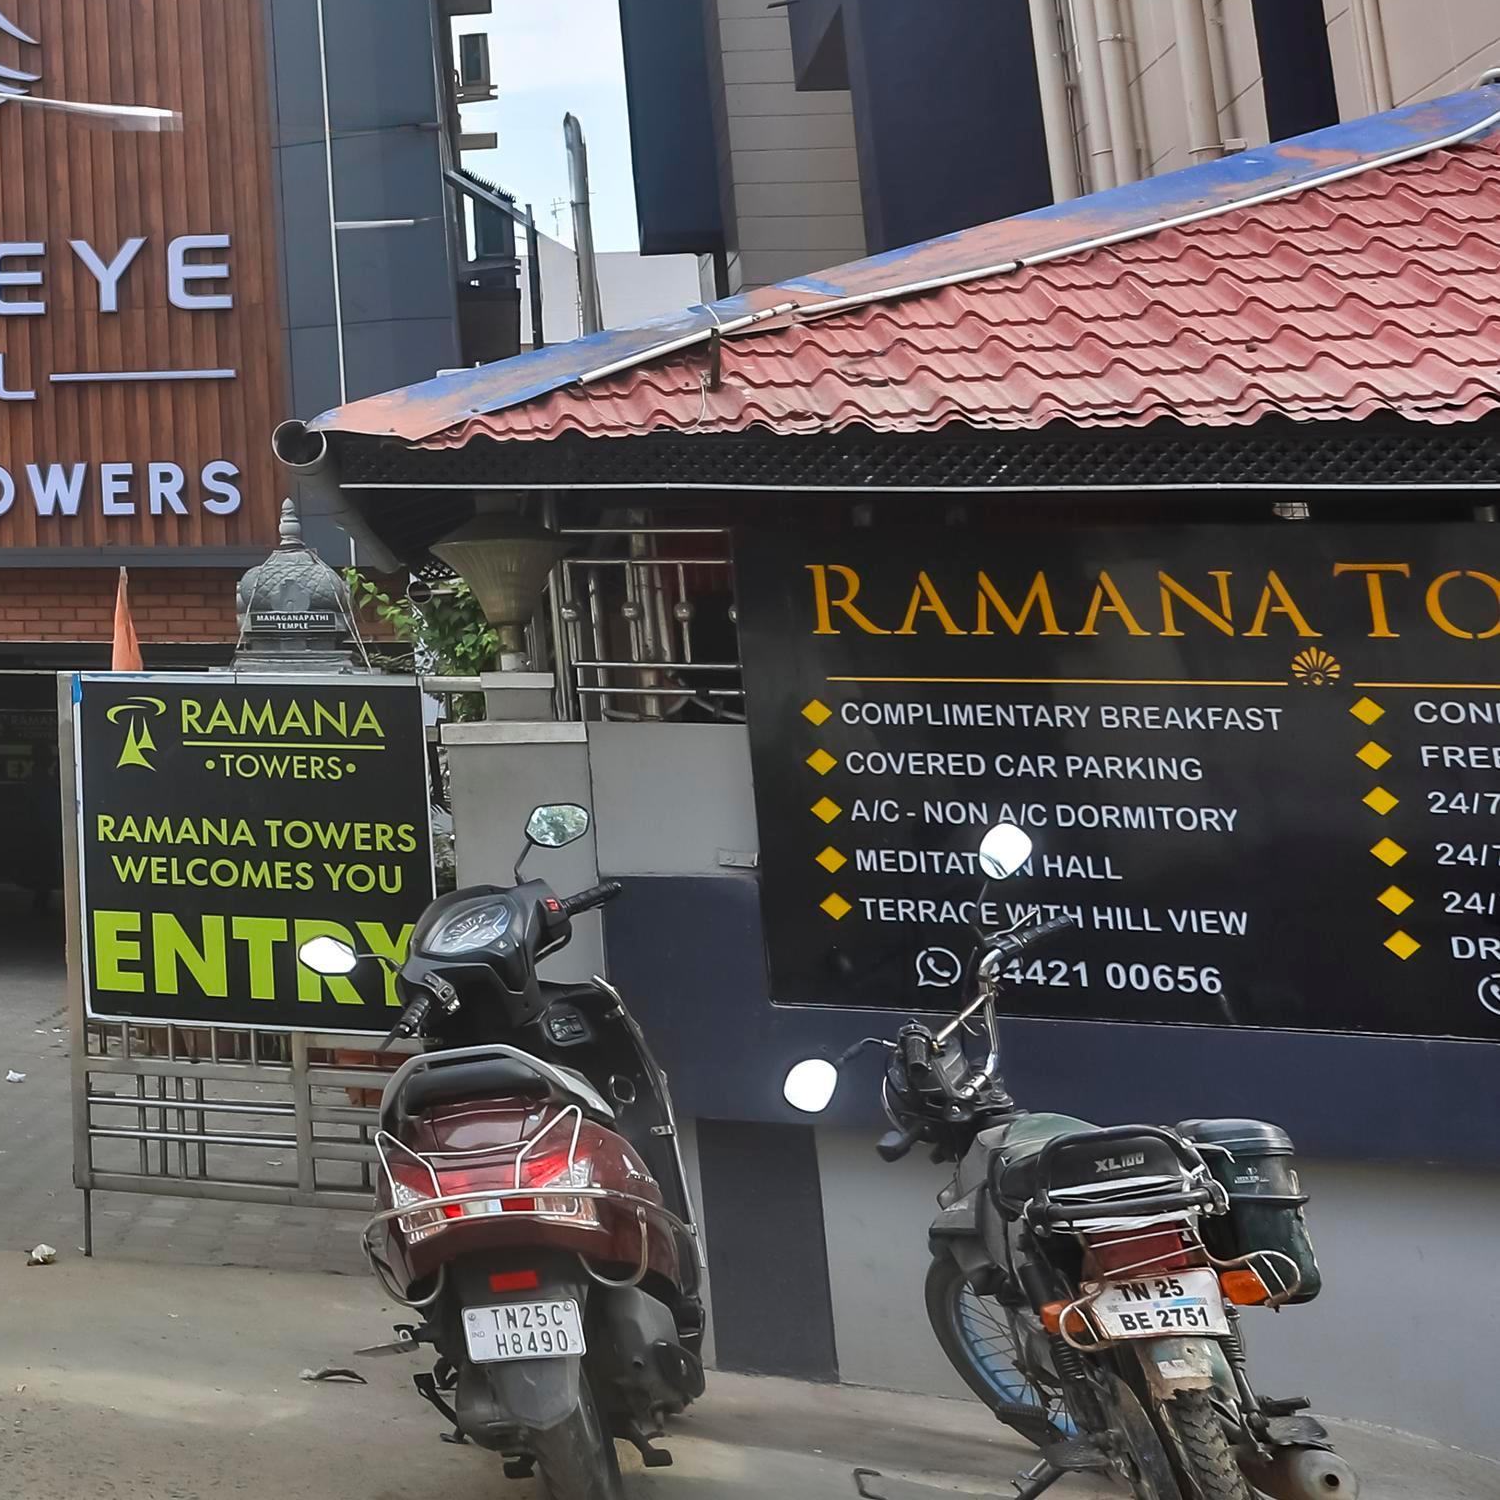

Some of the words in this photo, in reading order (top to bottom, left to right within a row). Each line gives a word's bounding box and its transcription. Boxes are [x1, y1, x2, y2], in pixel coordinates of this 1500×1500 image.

[804, 564, 1323, 637] RAMANA
[1333, 563, 1500, 639] TO
[181, 698, 385, 738] RAMANA
[841, 702, 1090, 728] COMPLIMENTARY
[1100, 707, 1283, 731] BREAKFAST
[1414, 701, 1500, 724] CON
[220, 754, 342, 780] TOWERS
[845, 752, 985, 776] COVERED
[995, 755, 1057, 778] CAR
[1066, 756, 1203, 782] PARKING
[851, 800, 899, 823] A/C
[924, 801, 988, 825] NON
[999, 802, 1048, 827] A/C
[1056, 804, 1238, 832] DORMITORY
[98, 814, 256, 847] RAMANA
[265, 820, 416, 852] TOWERS
[111, 855, 314, 891] WELCOMES
[323, 863, 402, 894] YOU
[855, 849, 1034, 877] MEDITATN
[1043, 855, 1123, 879] HALL
[1093, 906, 1161, 932] HILL
[1168, 908, 1248, 936] VIEW
[1106, 966, 1222, 995] 00656
[1095, 1152, 1145, 1173] XL100
[1115, 1280, 1151, 1302] TN
[1155, 1276, 1184, 1299] 25
[491, 1304, 563, 1330] TN25C
[1119, 1312, 1153, 1331] BE
[1156, 1307, 1209, 1328] 2751
[496, 1329, 569, 1356] H8490
